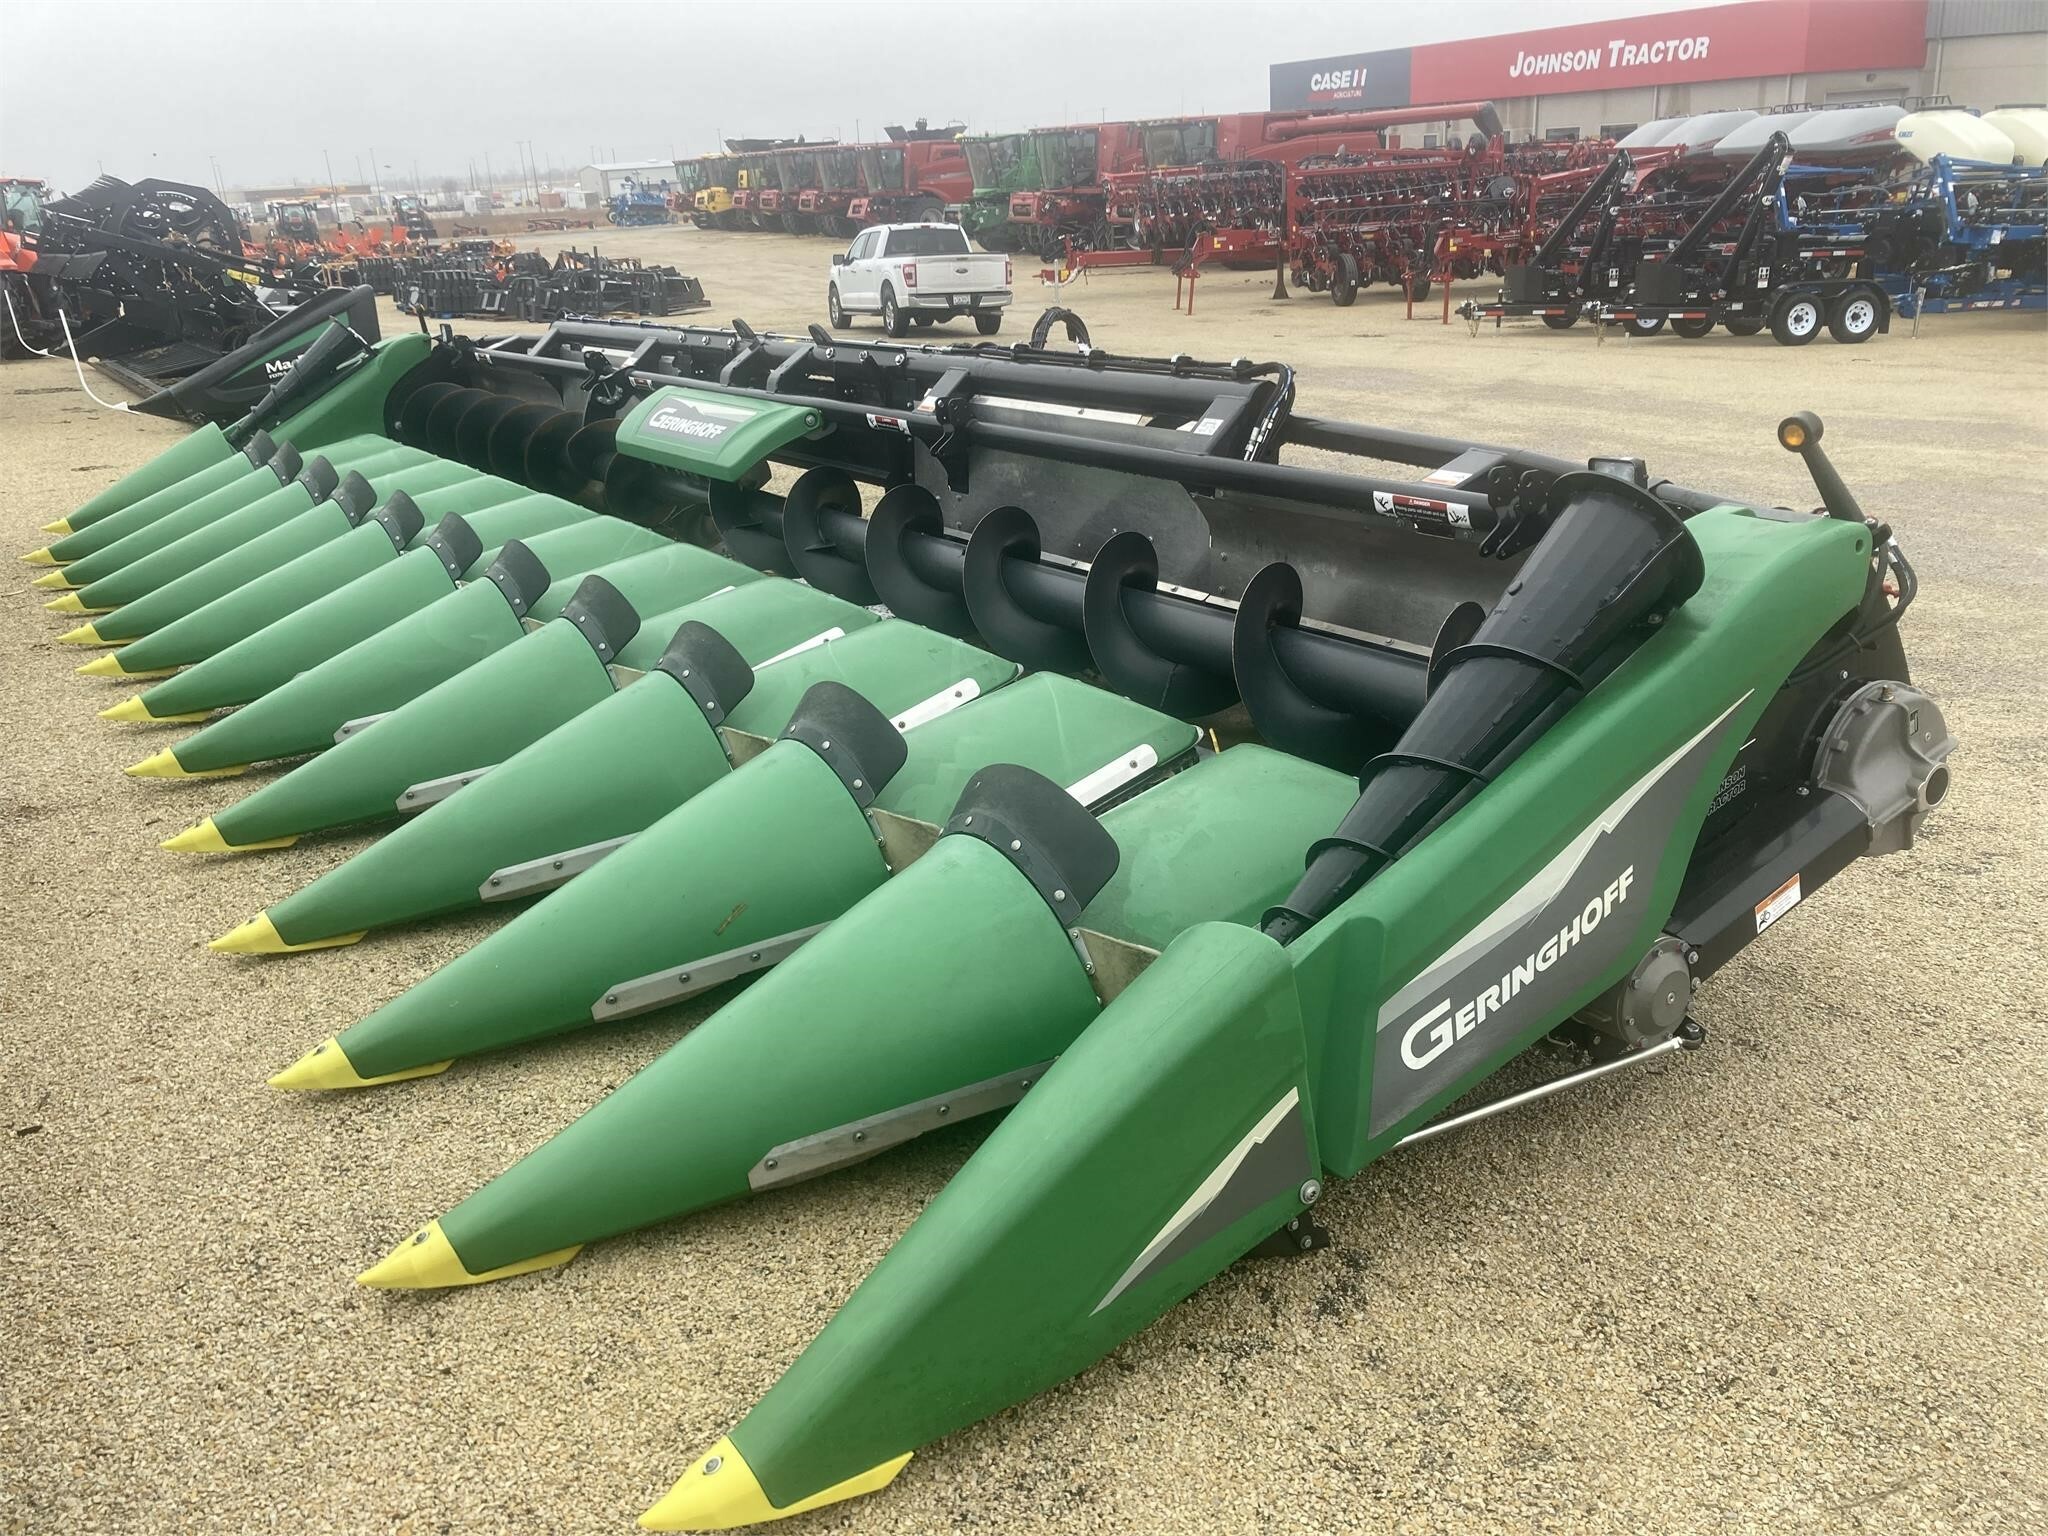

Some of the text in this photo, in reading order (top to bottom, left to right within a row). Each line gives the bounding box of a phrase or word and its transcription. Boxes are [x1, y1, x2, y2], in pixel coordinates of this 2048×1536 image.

[1510, 36, 1711, 78] JOHNSON TRACTOR
[1310, 70, 1352, 92] CASE
[649, 407, 727, 439] GERINGHOFF
[1413, 499, 1431, 507] DANGER
[1400, 864, 1635, 1071] GERINGHOFF
